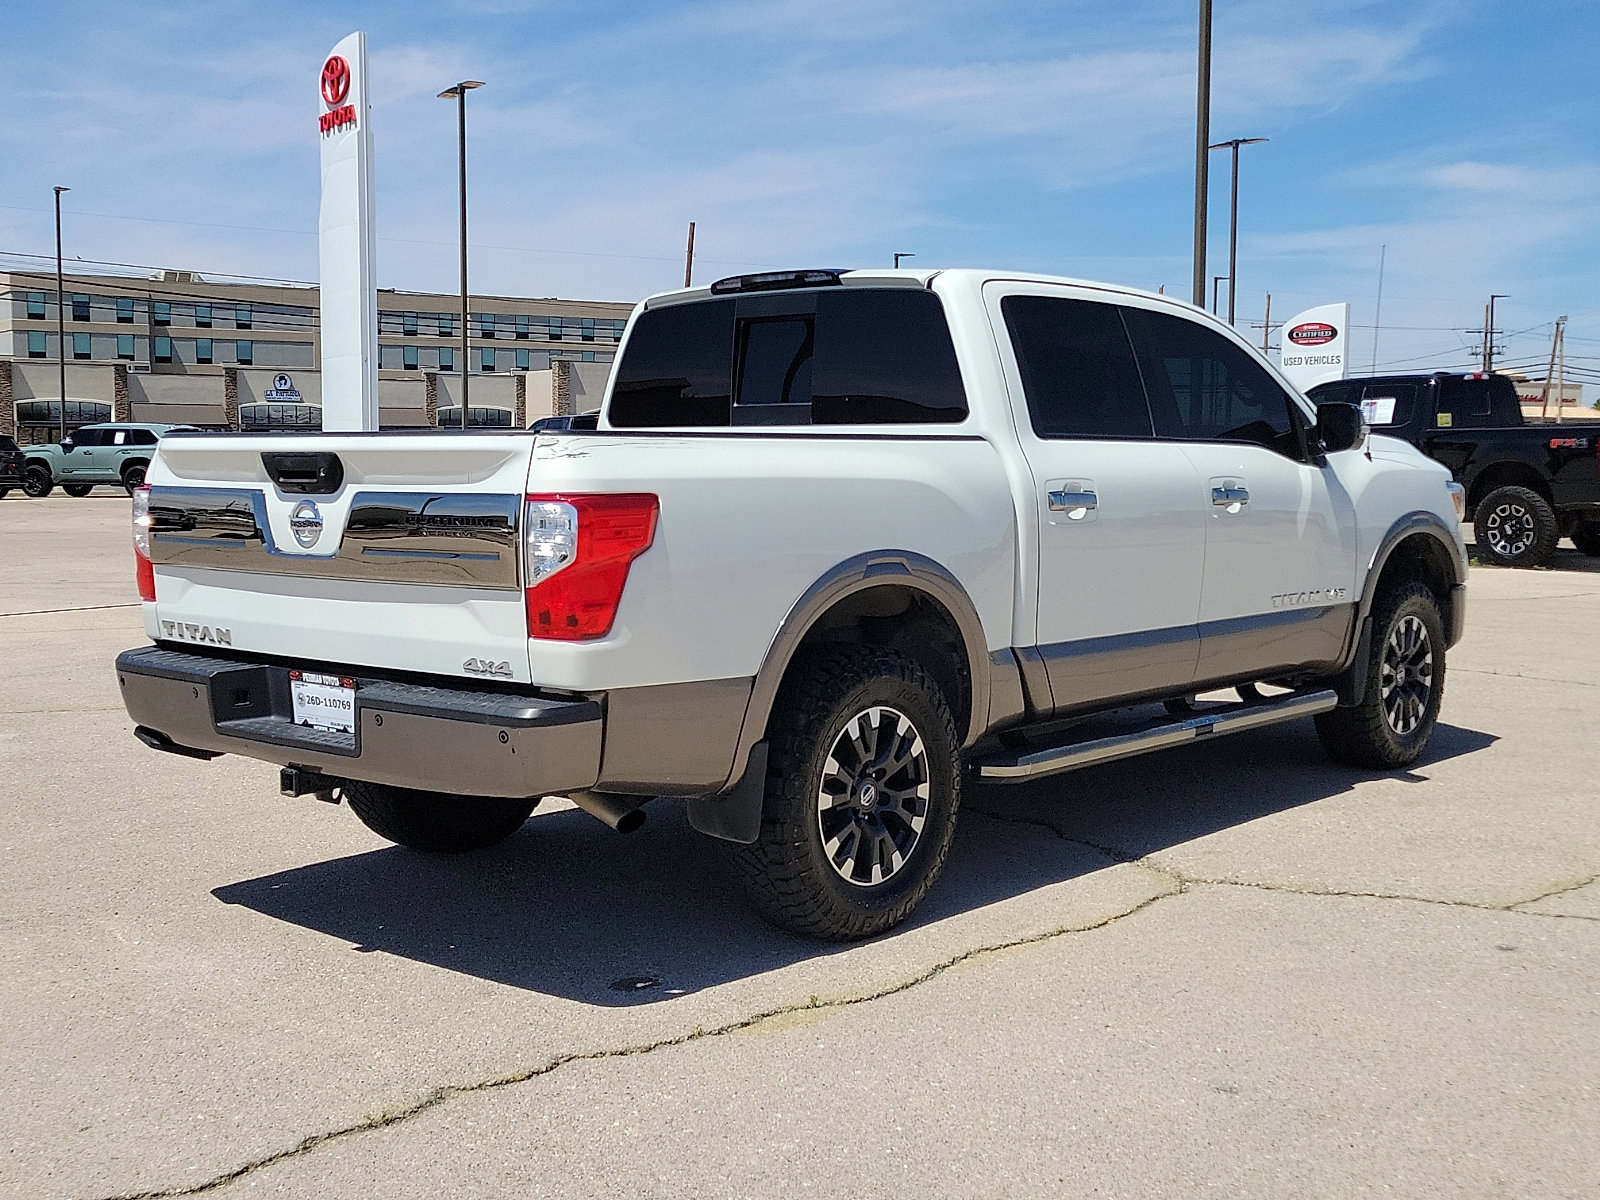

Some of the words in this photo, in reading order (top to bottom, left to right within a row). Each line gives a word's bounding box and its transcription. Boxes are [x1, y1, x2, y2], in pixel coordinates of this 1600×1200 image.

[318, 104, 357, 133] TOYOTA
[1283, 356, 1303, 366] USED
[1304, 355, 1341, 366] VEHICLES
[1550, 438, 1588, 449] FX4
[291, 519, 323, 528] NISSAN
[1271, 591, 1320, 608] TITAN
[161, 619, 232, 646] TITAN
[305, 694, 351, 710] 26D-110769
